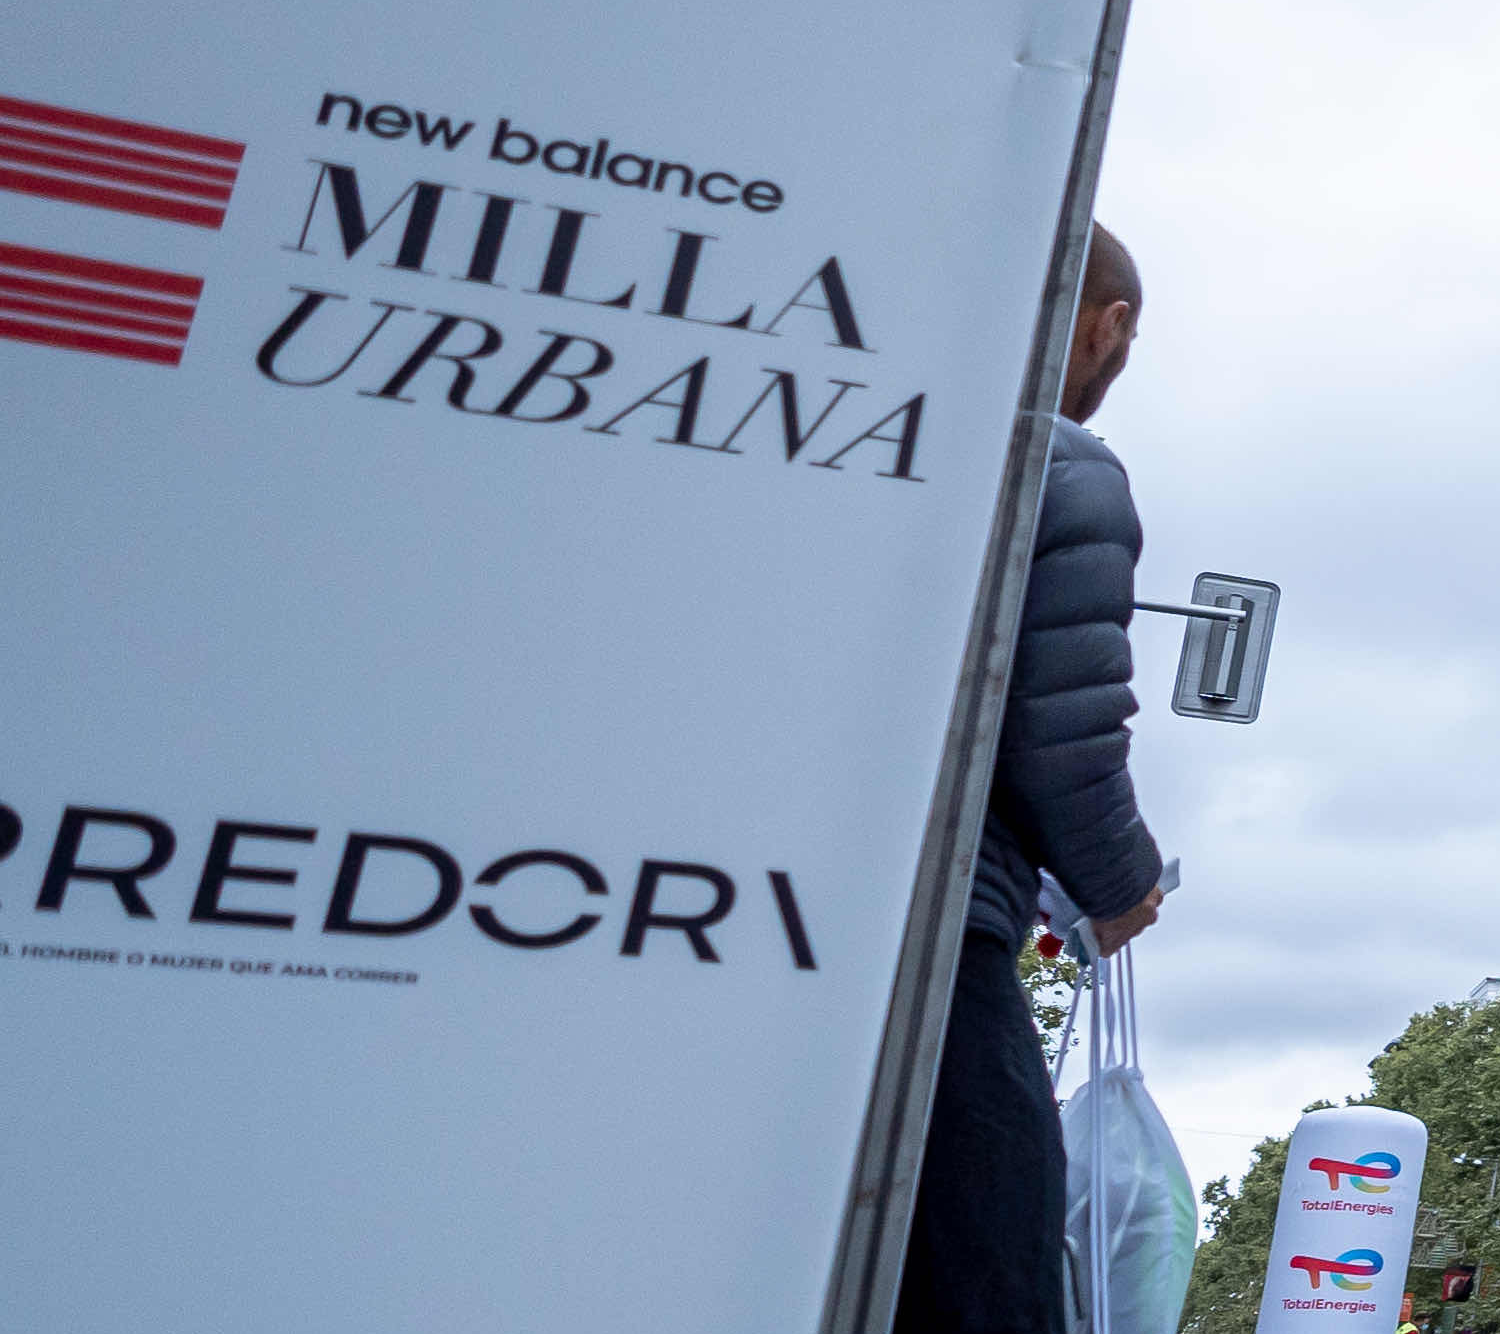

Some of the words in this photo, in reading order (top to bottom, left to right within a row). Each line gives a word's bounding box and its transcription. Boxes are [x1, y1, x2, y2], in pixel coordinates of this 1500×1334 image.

[316, 91, 476, 151] new
[487, 116, 787, 214] balance
[283, 157, 879, 354] MILLA
[255, 286, 929, 482] URBANA
[21, 944, 121, 966] HOMBRE
[229, 960, 273, 978] QUE
[281, 963, 329, 980] AMA
[1301, 1200, 1394, 1216] TotalEnergies
[1281, 1298, 1377, 1314] TotalEnergies
